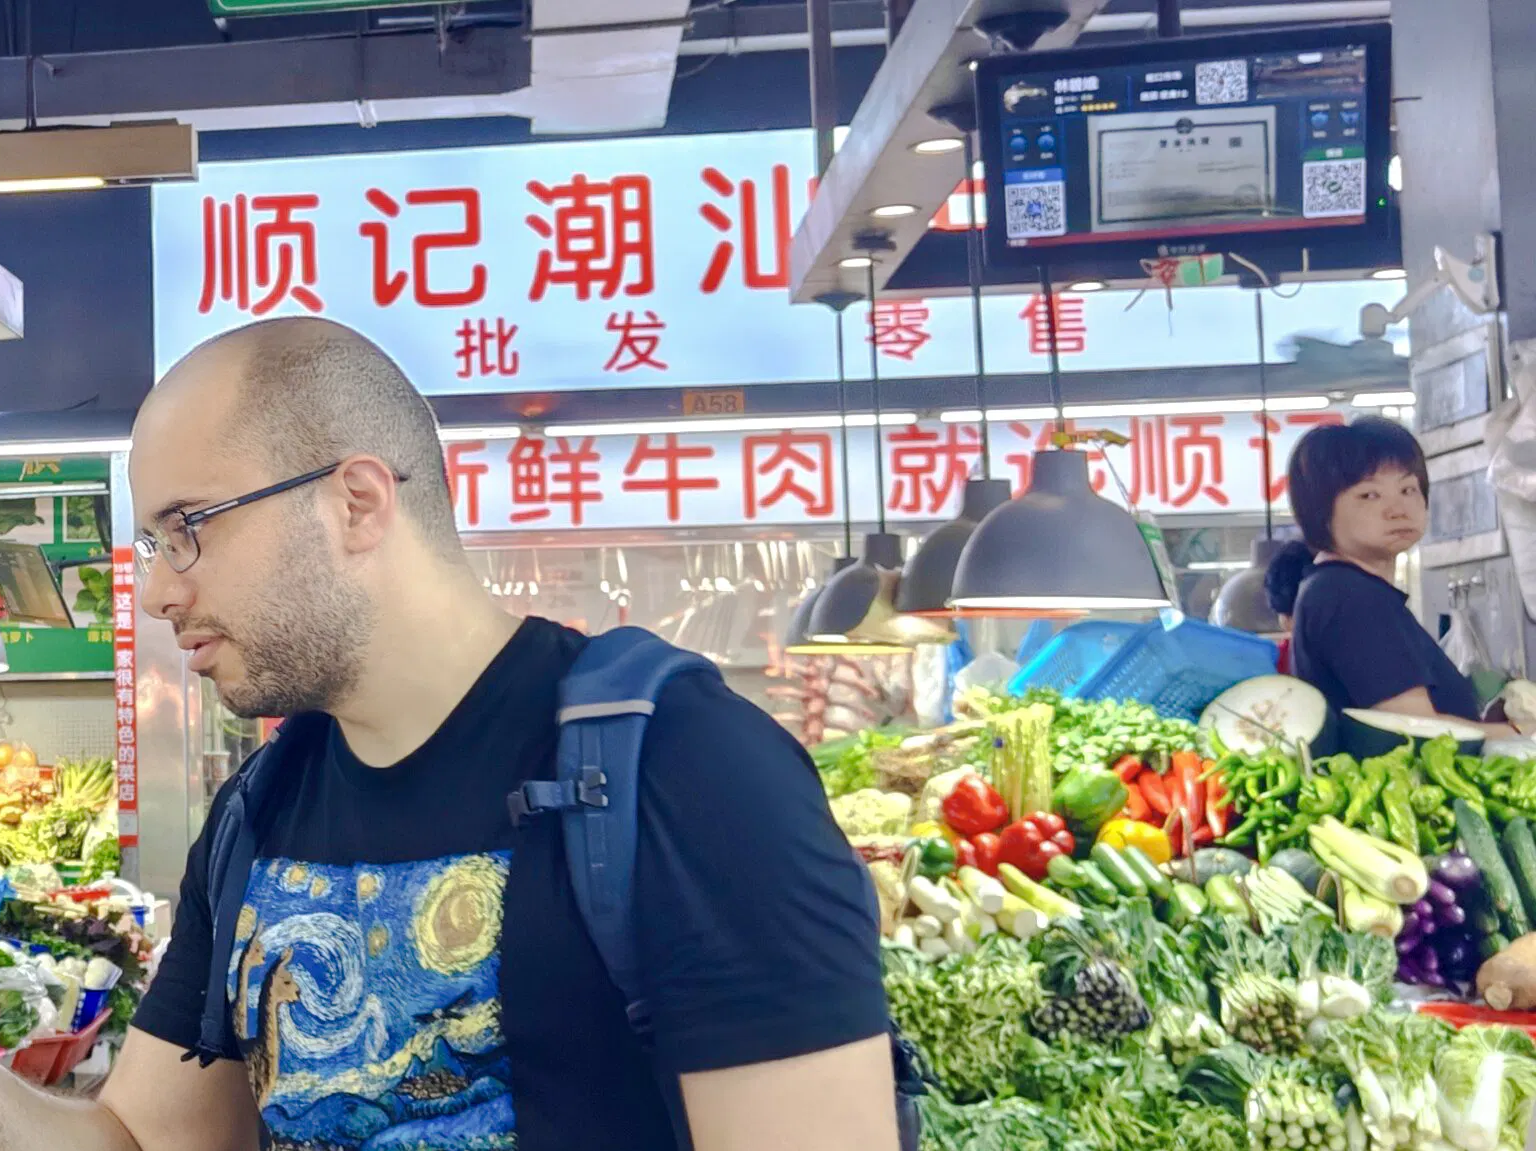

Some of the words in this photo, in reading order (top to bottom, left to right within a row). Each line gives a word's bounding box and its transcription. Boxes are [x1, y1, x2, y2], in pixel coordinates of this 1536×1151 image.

[454, 311, 668, 378] 批发
[865, 292, 1088, 361] 零售
[691, 394, 738, 414] A58
